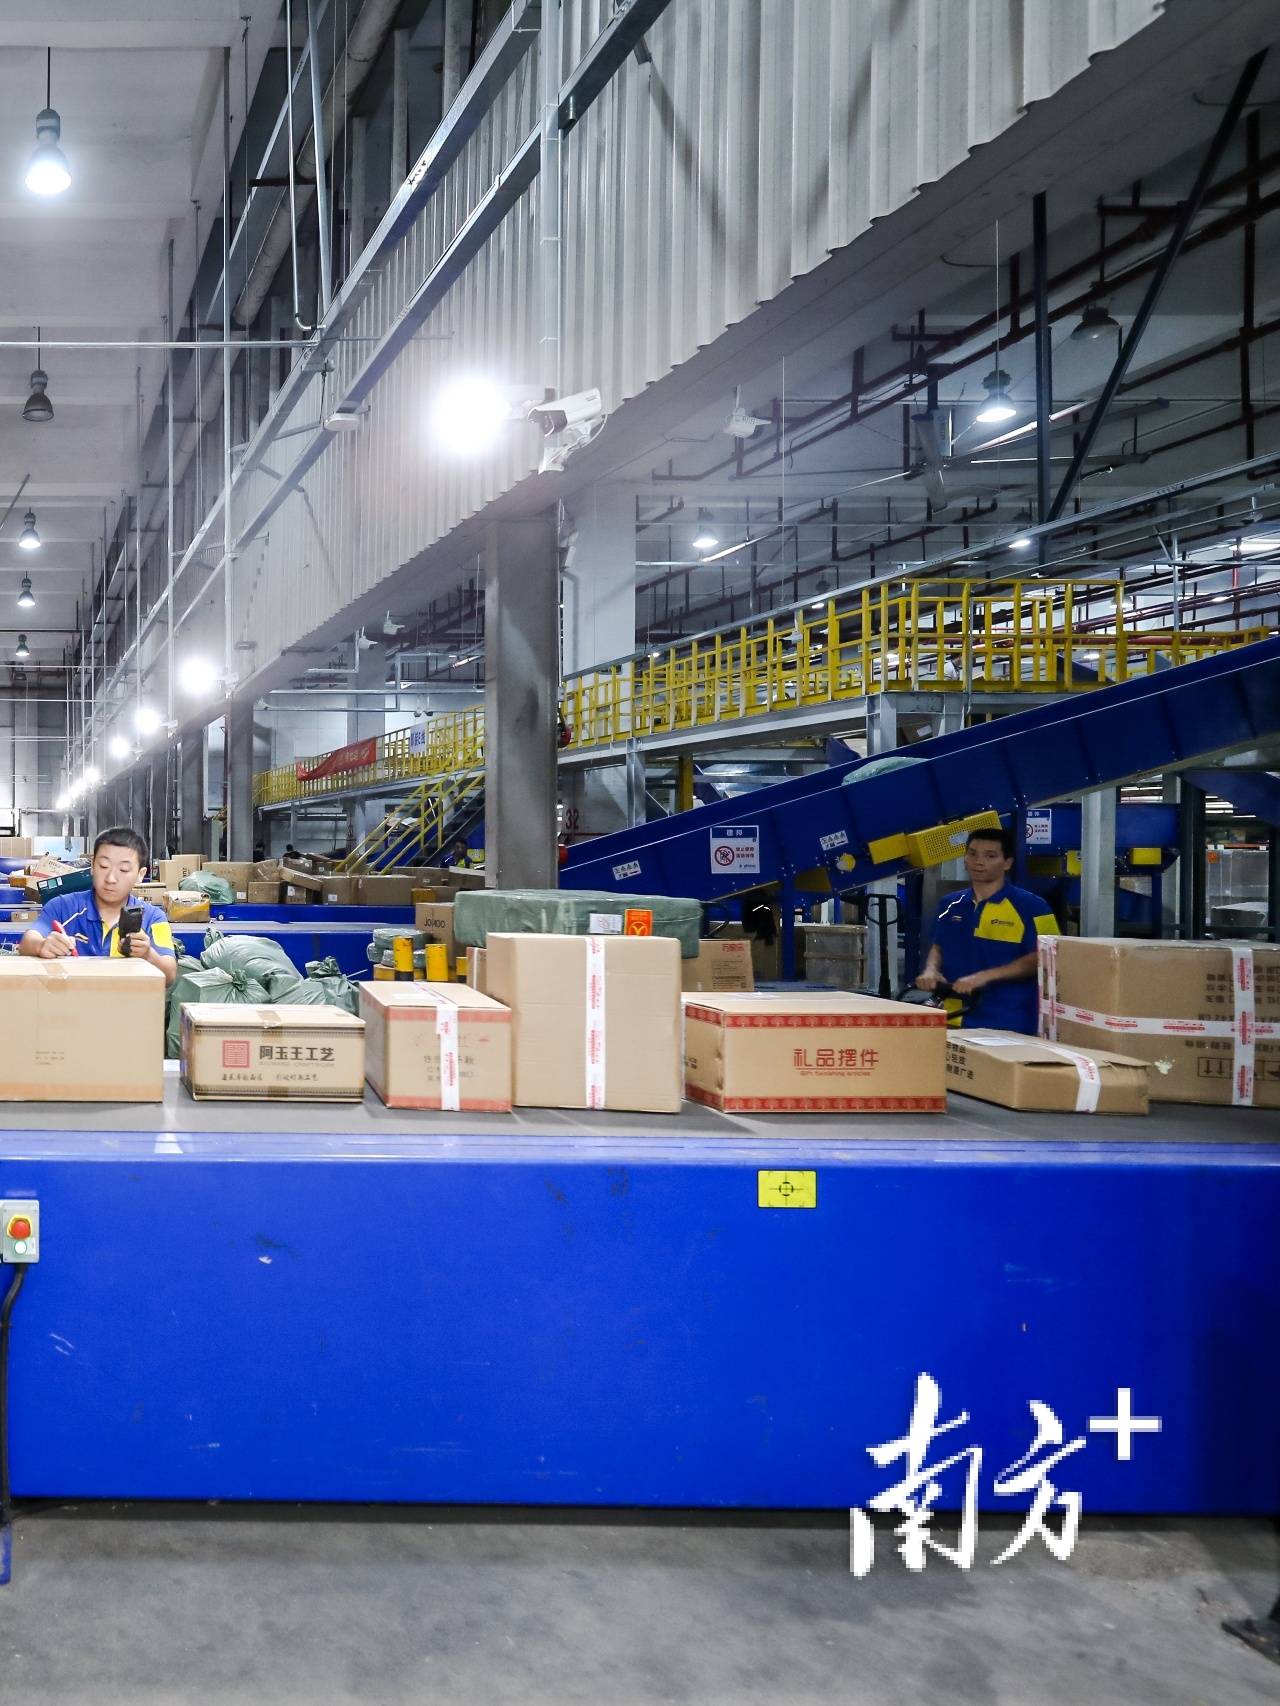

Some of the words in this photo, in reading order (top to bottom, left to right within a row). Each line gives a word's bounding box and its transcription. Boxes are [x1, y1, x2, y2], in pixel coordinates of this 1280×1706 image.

[259, 1045, 335, 1062] 阿玉王工艺
[794, 1049, 879, 1067] 礼品摆件
